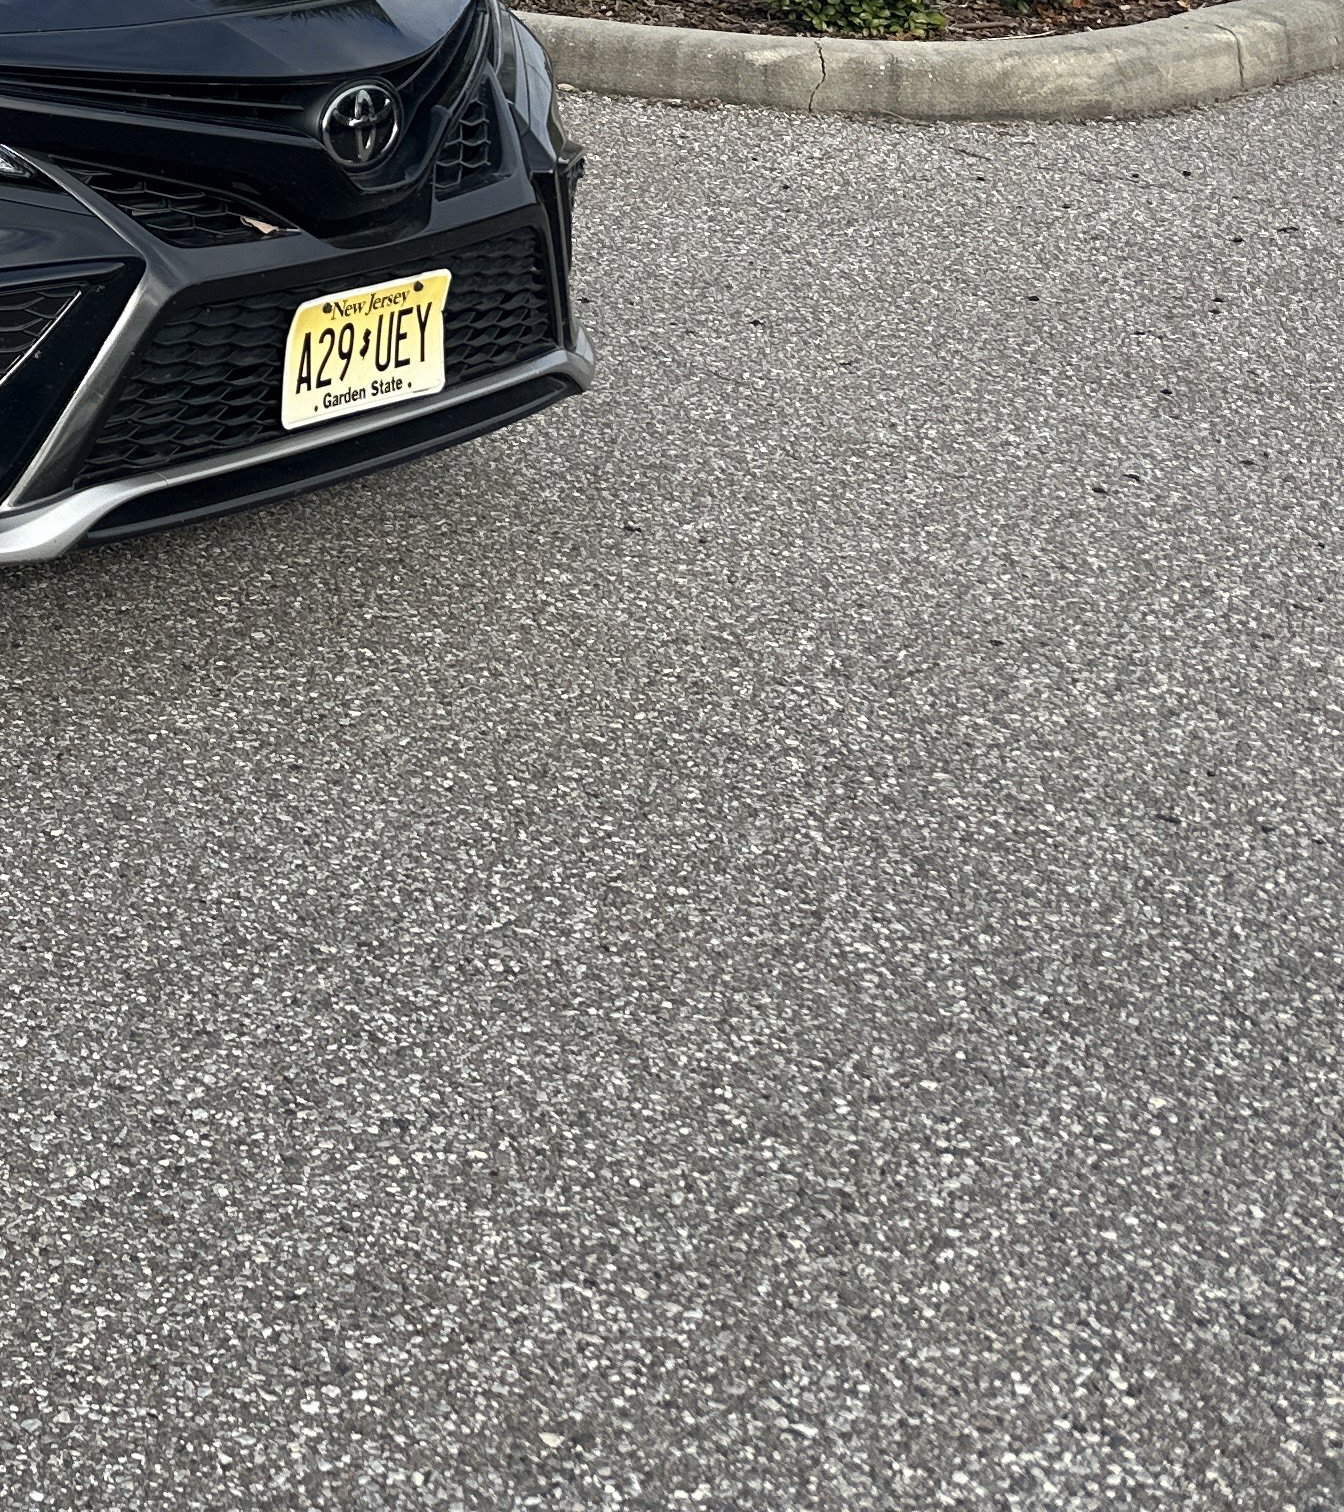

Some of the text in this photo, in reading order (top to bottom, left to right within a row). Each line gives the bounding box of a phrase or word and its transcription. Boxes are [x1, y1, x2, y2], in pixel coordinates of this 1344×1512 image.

[330, 289, 410, 321] New Jersey
[295, 301, 433, 395] A29 UEY
[322, 376, 403, 409] Garden State
